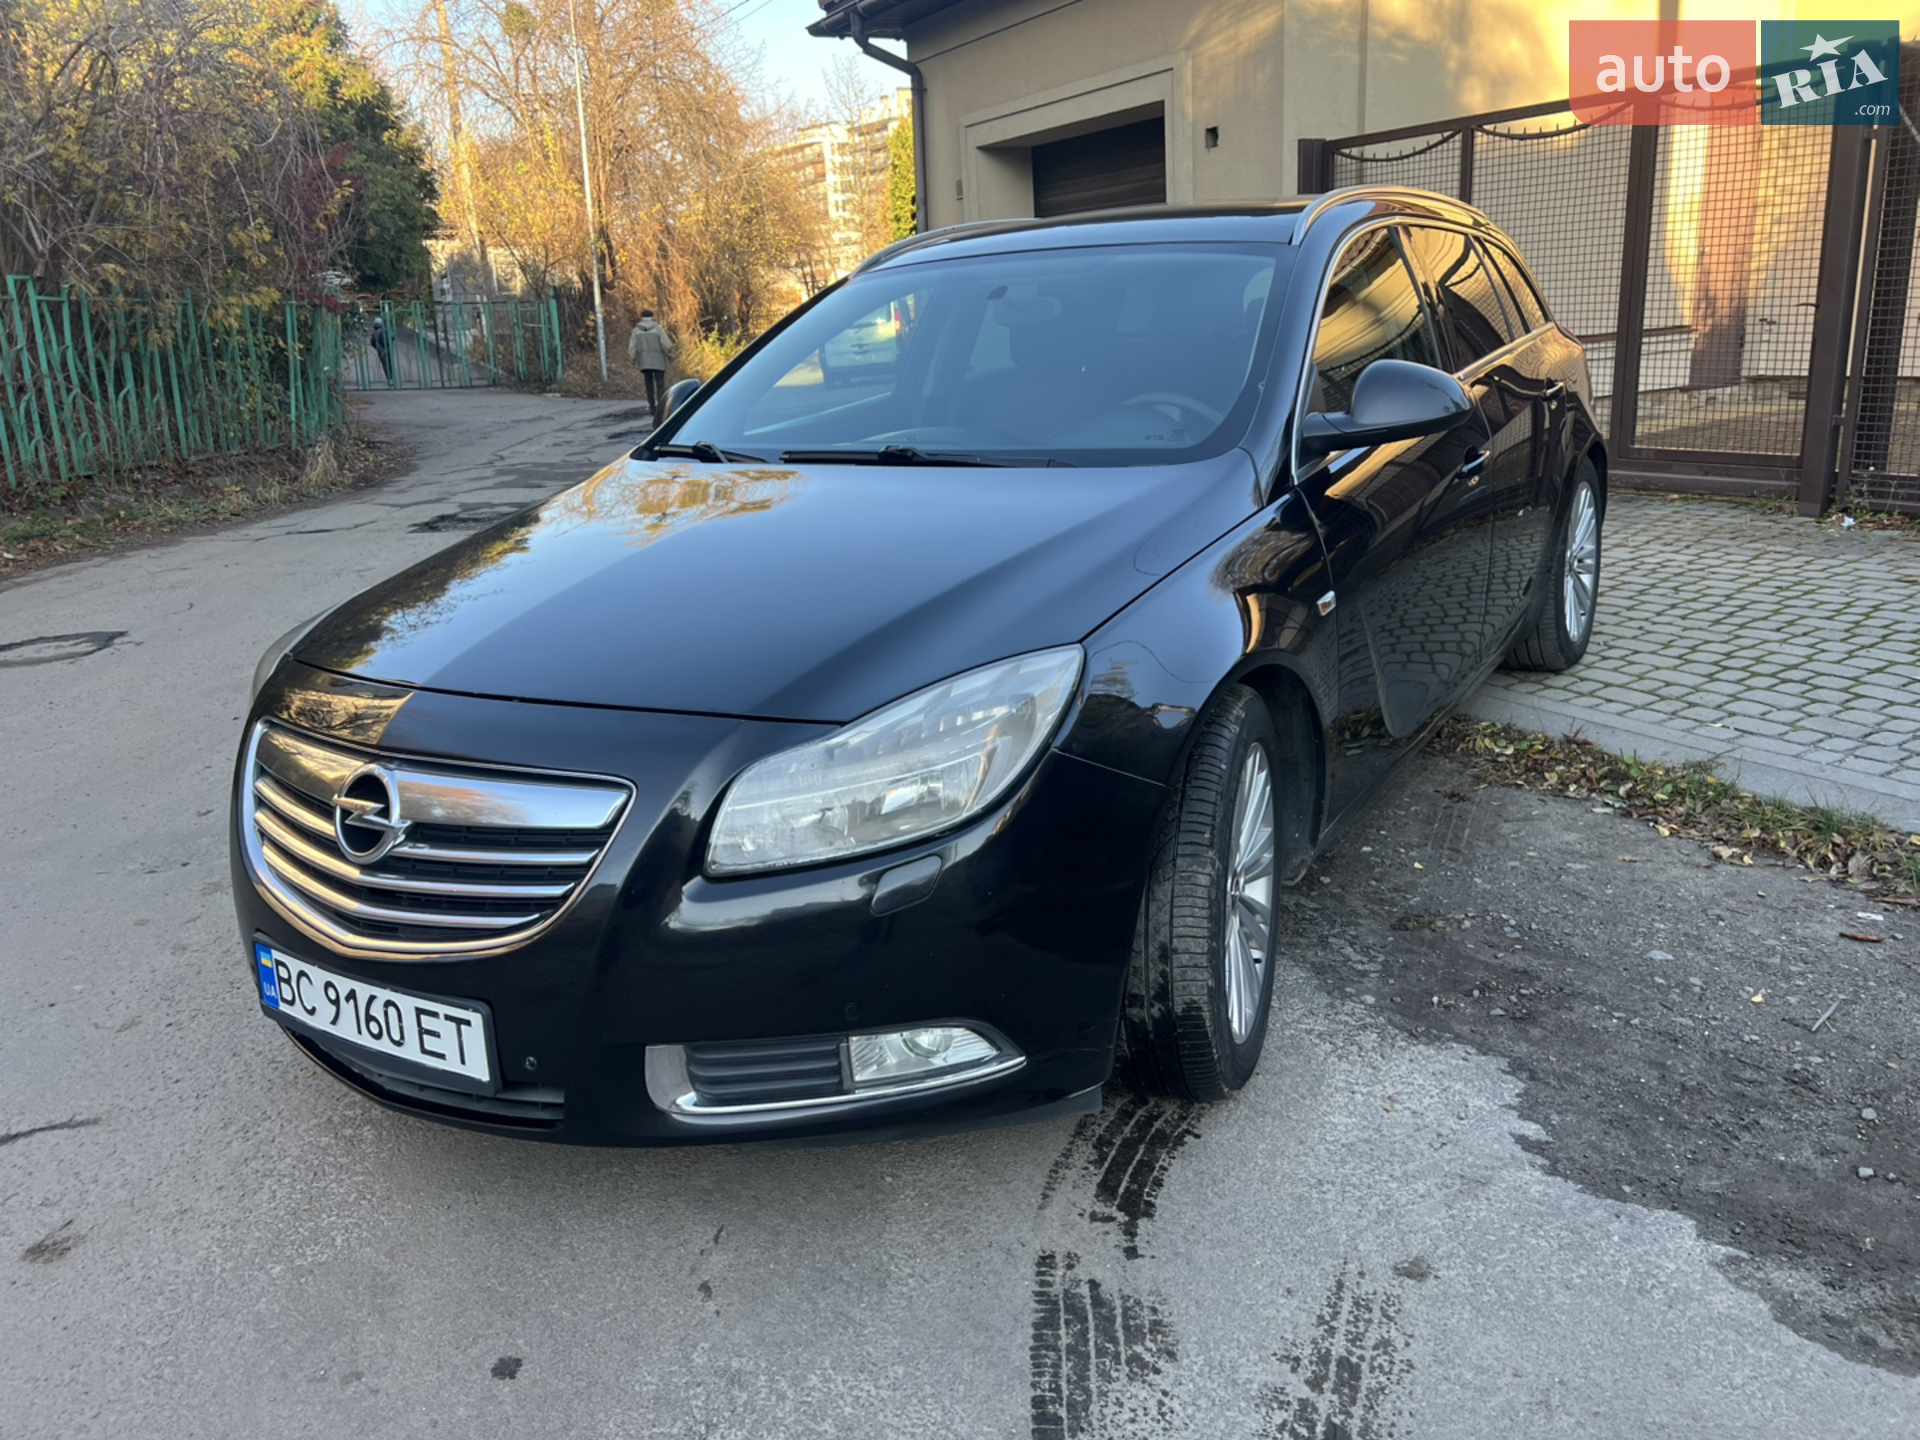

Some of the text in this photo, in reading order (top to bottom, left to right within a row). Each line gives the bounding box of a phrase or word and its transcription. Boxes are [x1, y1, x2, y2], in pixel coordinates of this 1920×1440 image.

[263, 982, 277, 998] UA
[274, 958, 473, 1066] BC 9160 ET
